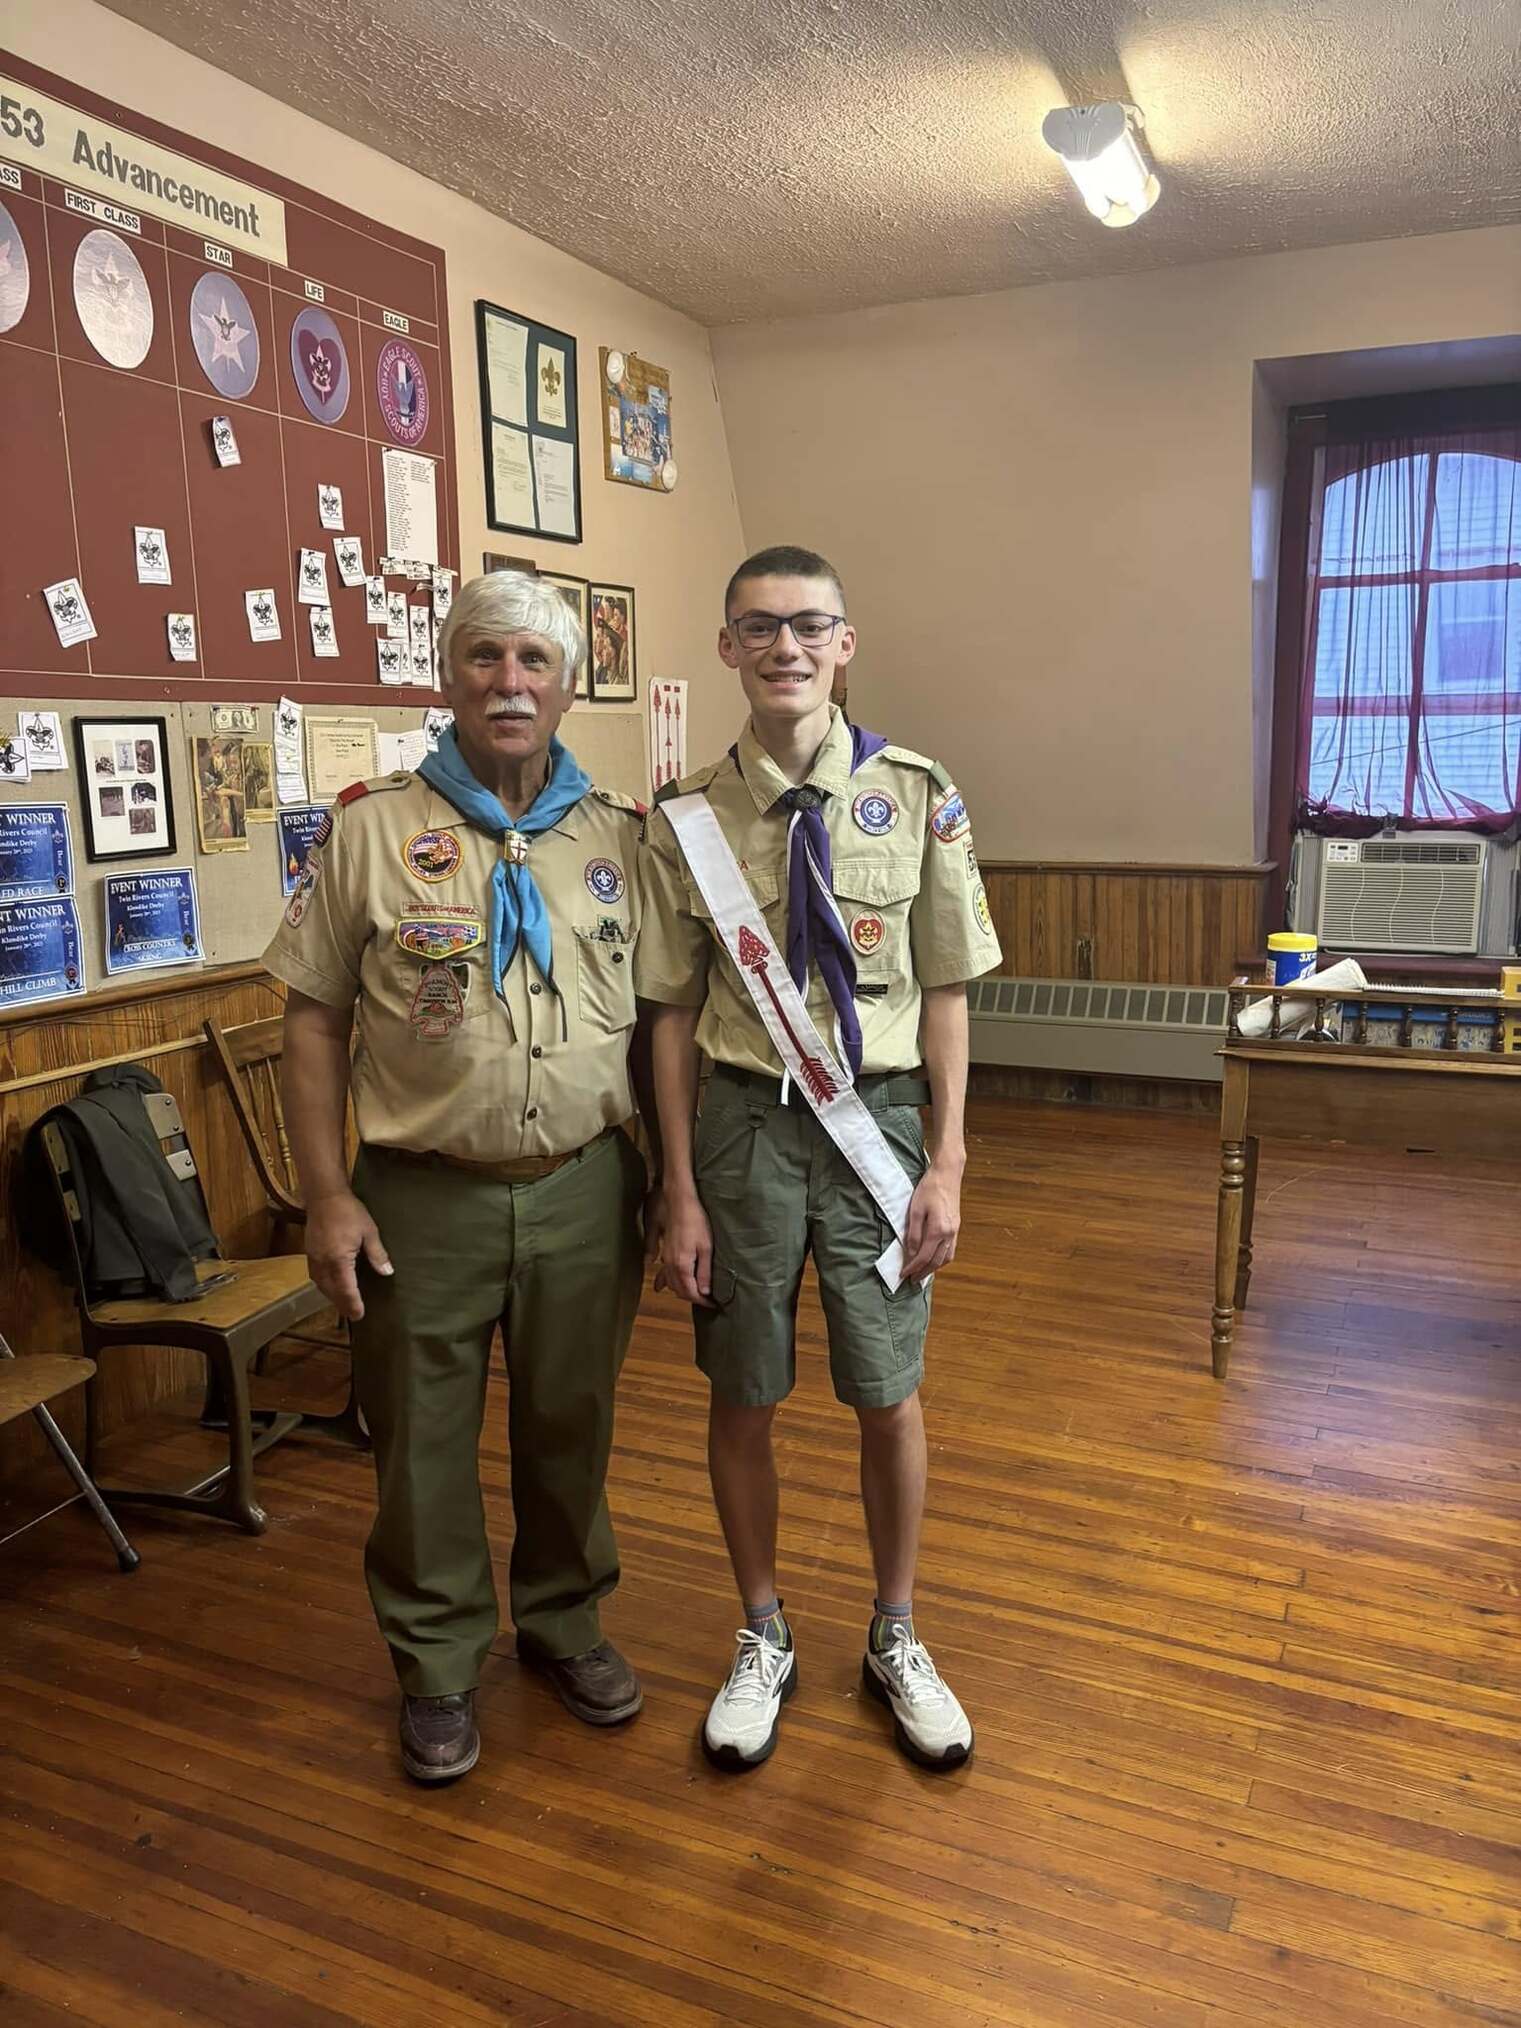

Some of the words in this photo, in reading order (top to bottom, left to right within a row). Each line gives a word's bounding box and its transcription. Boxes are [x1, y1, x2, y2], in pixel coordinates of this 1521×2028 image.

[0, 95, 46, 149] 53
[72, 129, 261, 238] Advancement
[67, 192, 97, 214] FIRST
[104, 207, 139, 230] CLASS
[206, 245, 231, 265] STAR
[306, 283, 323, 300] LIFE
[384, 313, 408, 331] EAGLE
[383, 345, 402, 371] EAGLE
[401, 347, 422, 379] SCOUT
[6, 812, 57, 826] WINNER
[284, 815, 308, 827] EVENT
[21, 826, 48, 837] Council
[17, 885, 44, 898] RACE
[110, 880, 137, 894] EVENT
[139, 877, 183, 890] WINNER
[14, 904, 66, 920] WINNER
[30, 919, 57, 929] Council
[25, 977, 57, 990] CLIMB
